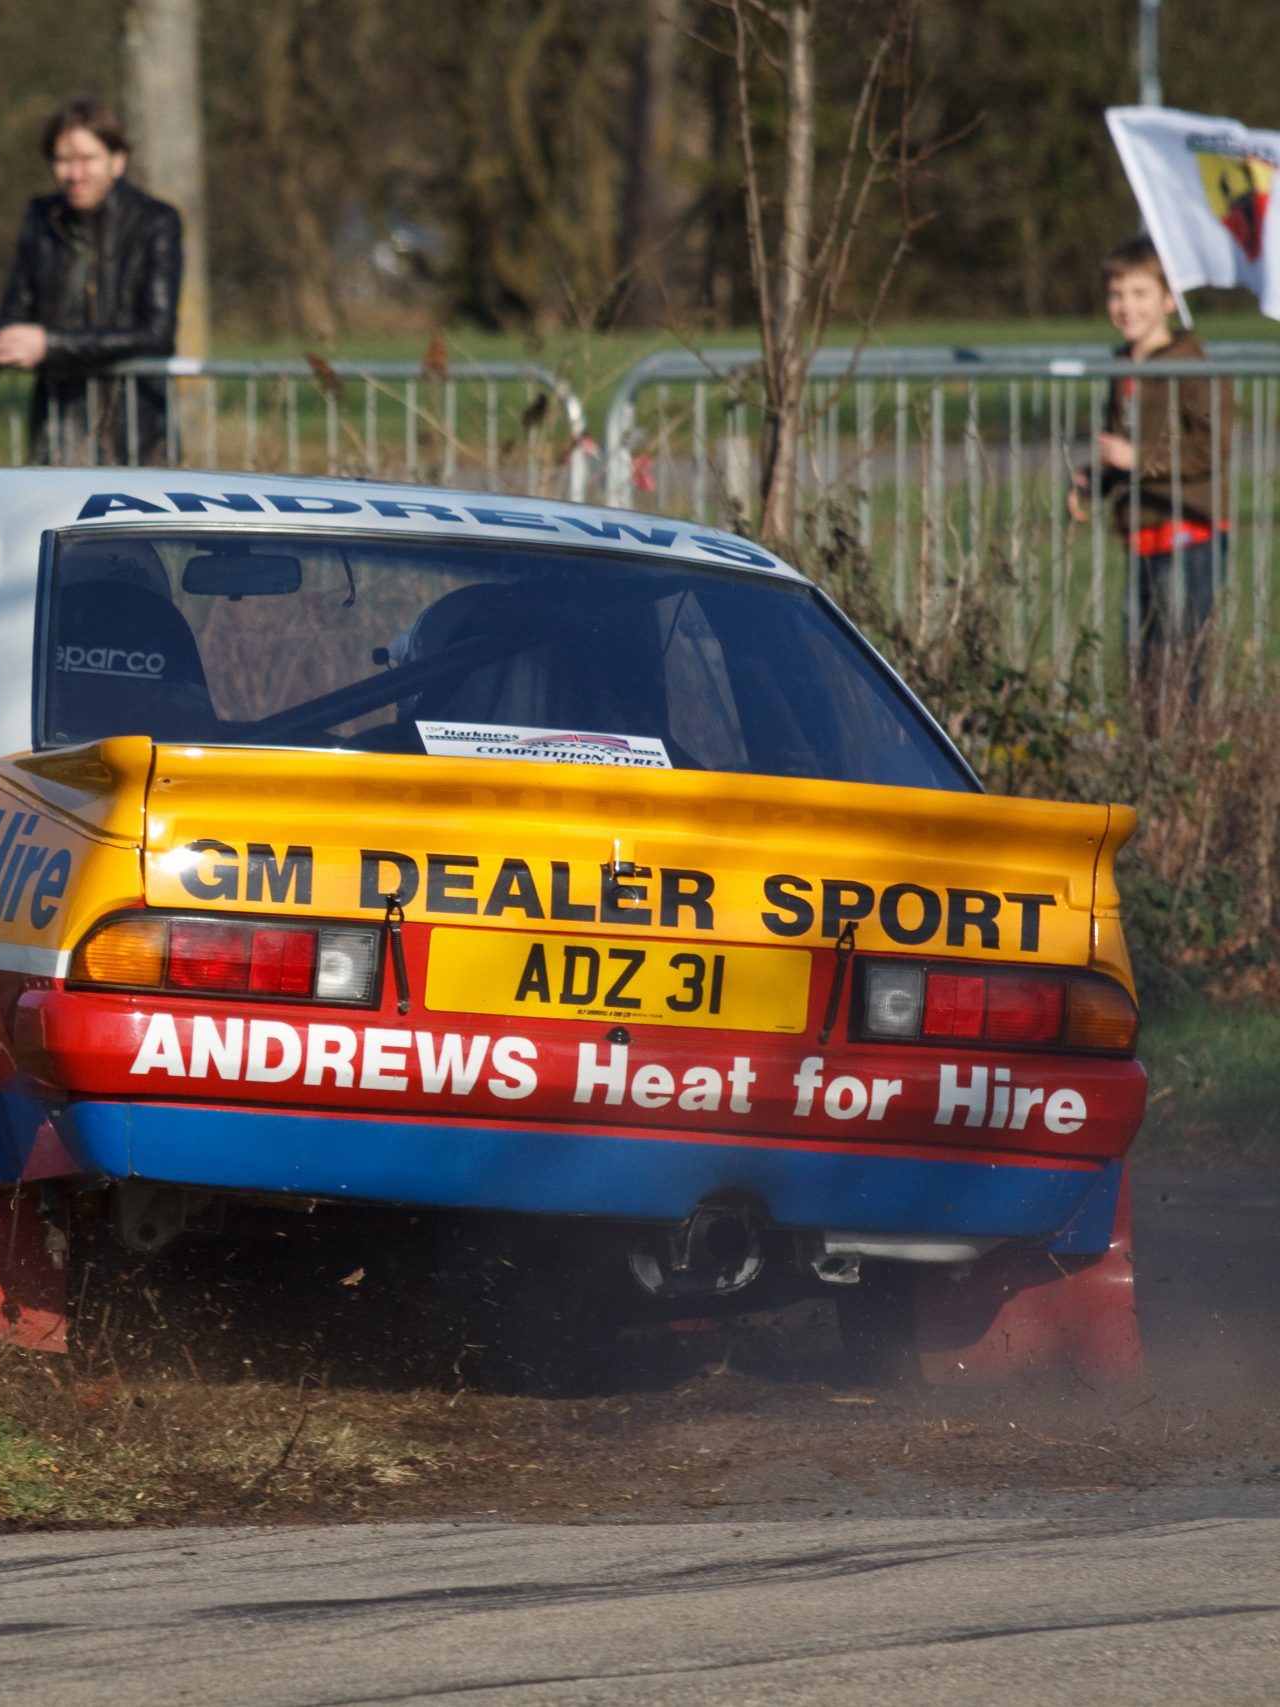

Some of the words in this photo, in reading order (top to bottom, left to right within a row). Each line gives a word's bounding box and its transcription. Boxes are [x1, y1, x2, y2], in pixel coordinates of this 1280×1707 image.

[77, 492, 778, 570] ANDREWS
[443, 729, 520, 741] Harkness
[476, 745, 605, 762] COMPETITION
[612, 755, 666, 768] TYRES
[179, 838, 314, 905] GM
[358, 849, 716, 931] DEALER
[761, 873, 1058, 953] SPORT
[514, 942, 647, 1010] ADZ
[665, 952, 726, 1015] 31
[129, 1012, 539, 1099] ANDREWS
[572, 1042, 757, 1114] Heat
[792, 1056, 903, 1121] for
[933, 1064, 1088, 1135] Hire
